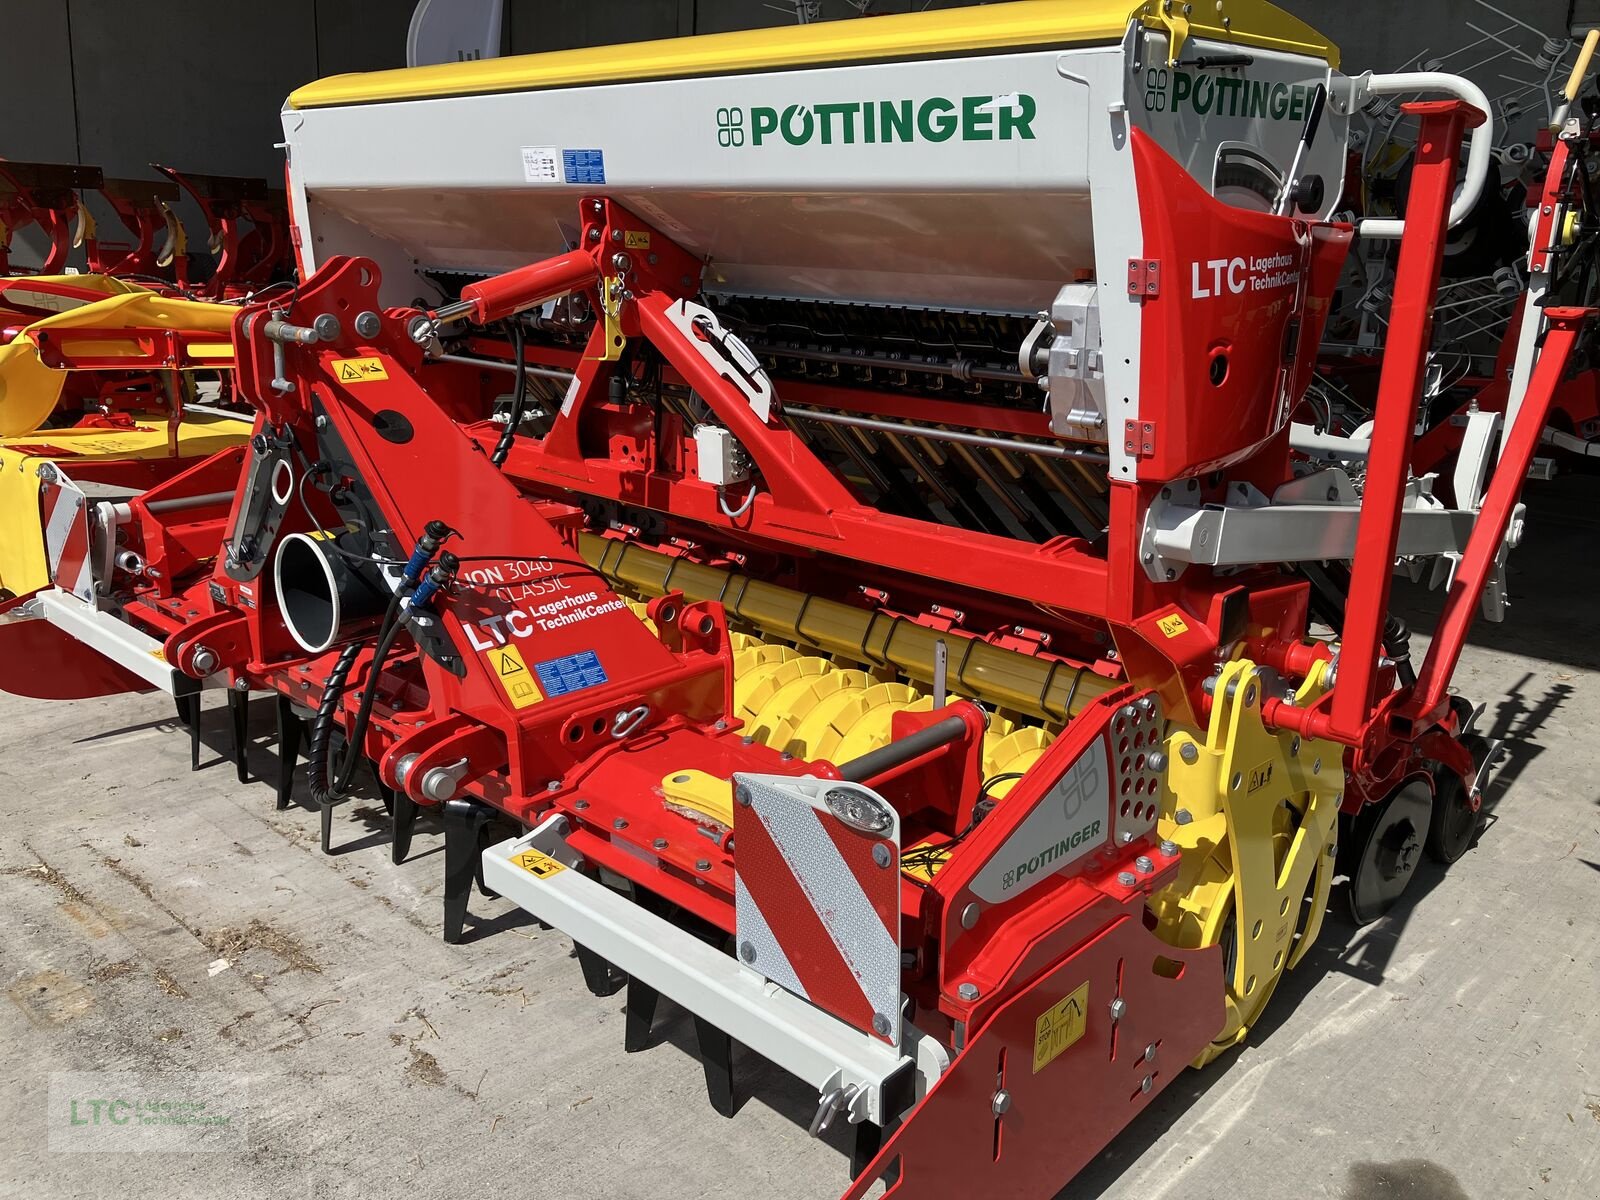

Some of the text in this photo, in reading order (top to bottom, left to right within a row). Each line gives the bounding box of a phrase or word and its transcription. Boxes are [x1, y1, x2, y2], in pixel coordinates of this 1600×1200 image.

[750, 93, 1037, 146] PÖTTINGER
[1192, 257, 1247, 299] LTC
[1249, 252, 1293, 273] Lagerhaus
[504, 555, 553, 580] 3040
[496, 573, 571, 603] CLASSIC
[529, 591, 598, 618] Lagerhaus
[536, 599, 628, 631] TechnikCenter
[462, 609, 534, 652] LTC
[1015, 820, 1101, 882] PÖTTINGER
